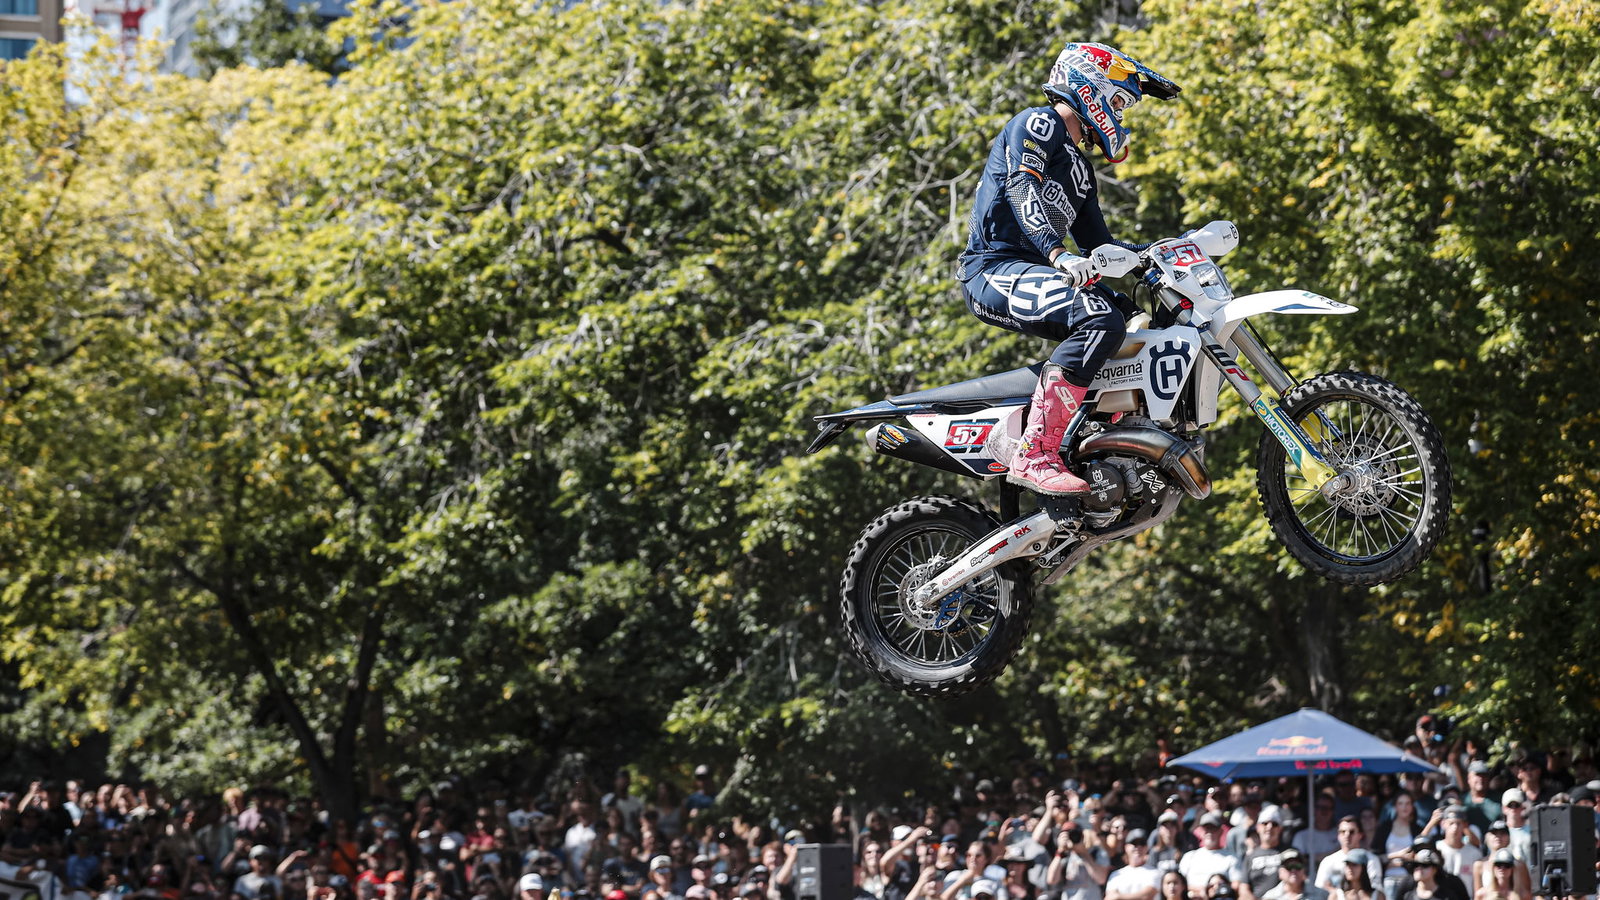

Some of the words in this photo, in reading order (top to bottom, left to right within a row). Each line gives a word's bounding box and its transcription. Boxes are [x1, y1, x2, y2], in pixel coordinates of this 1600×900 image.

[1078, 85, 1101, 113] Red
[1094, 112, 1117, 137] Bull
[1175, 245, 1202, 264] 57
[1094, 362, 1143, 381] sqvarna
[952, 426, 985, 445] 57
[1263, 413, 1300, 455] MOTOREX
[1013, 524, 1033, 539] RK
[947, 568, 966, 582] brembo
